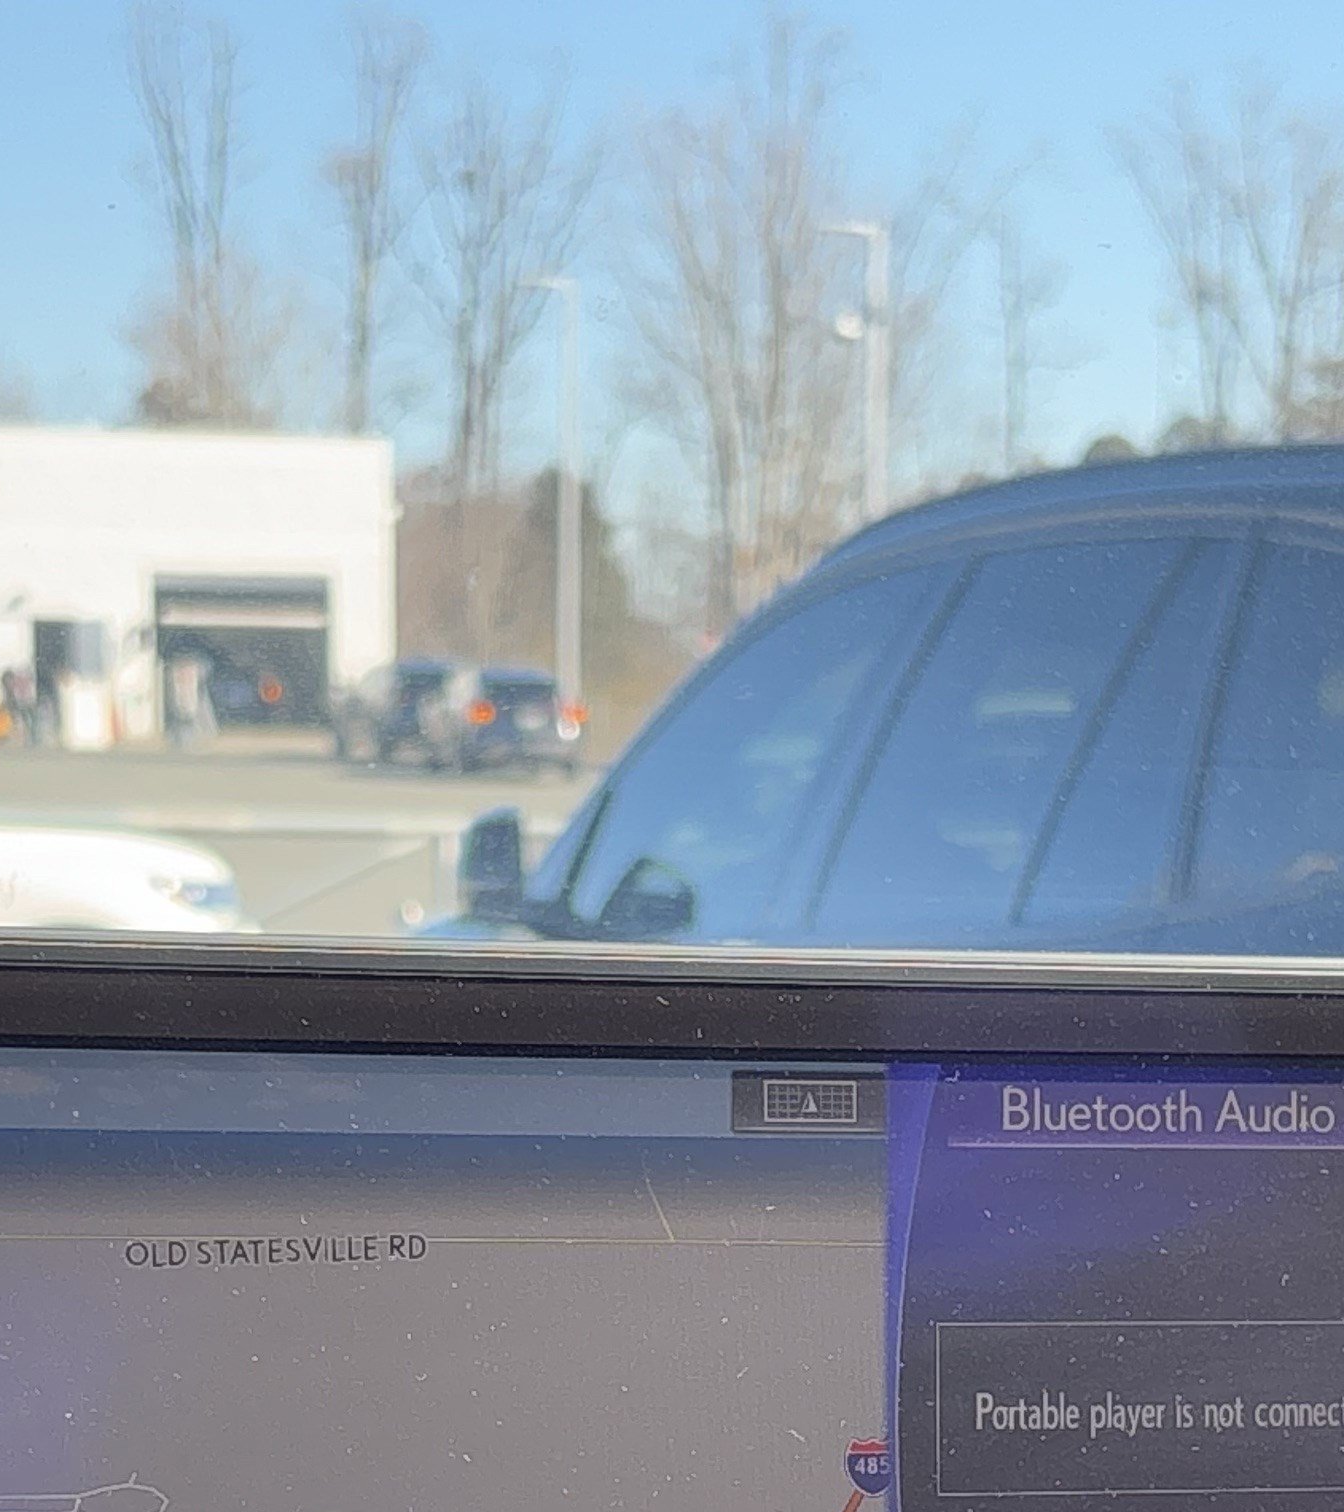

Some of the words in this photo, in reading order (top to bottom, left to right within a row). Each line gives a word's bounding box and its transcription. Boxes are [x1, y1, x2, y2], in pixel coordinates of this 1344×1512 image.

[1001, 1086, 1203, 1133] Bluetooth
[1216, 1089, 1336, 1135] Audio
[125, 1240, 187, 1267] OLD
[196, 1235, 380, 1265] STATESVILLE
[388, 1234, 426, 1260] RD
[975, 1391, 1080, 1431] Portable
[1089, 1395, 1165, 1438] player
[1174, 1394, 1194, 1429] is
[1202, 1397, 1245, 1430] not
[854, 1456, 891, 1475] 485
